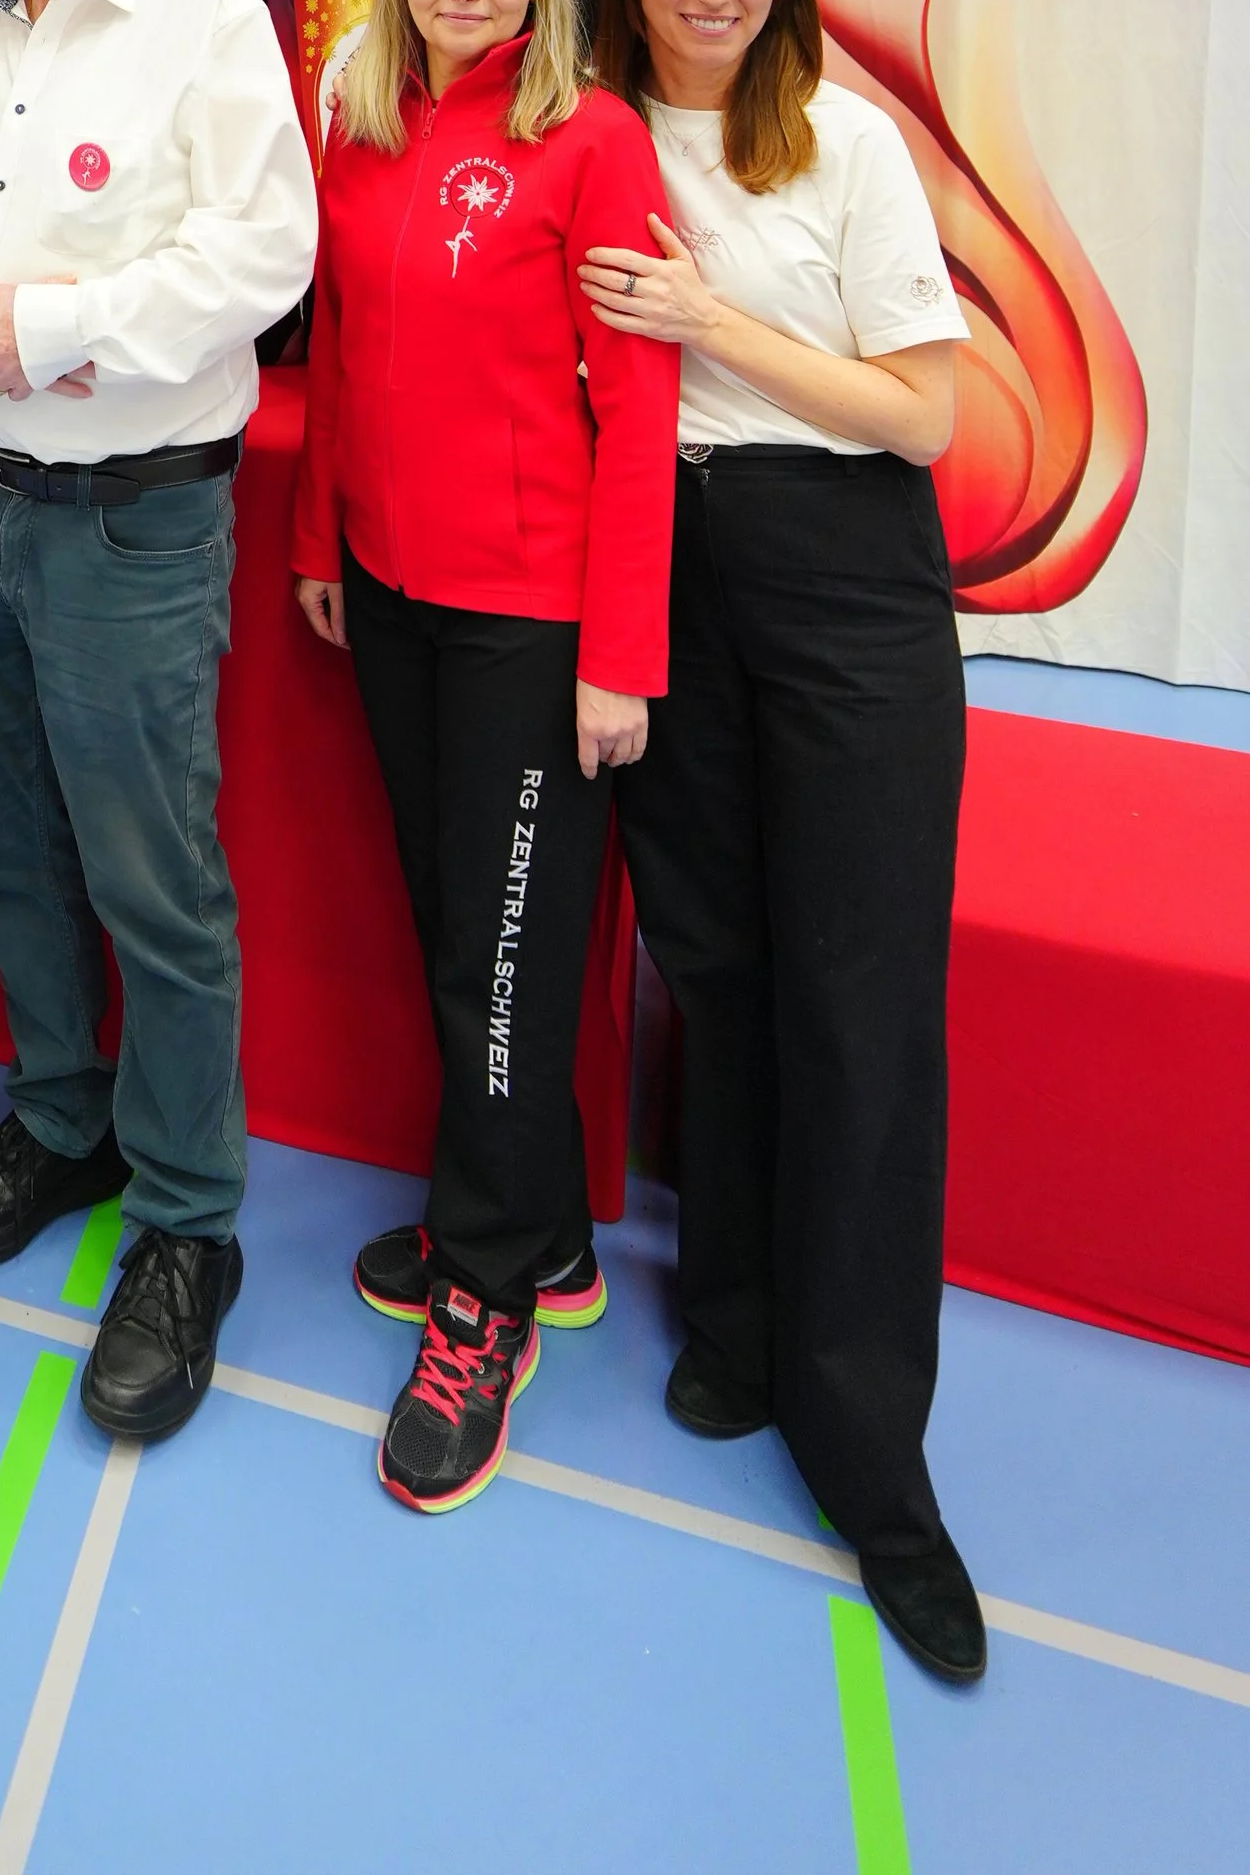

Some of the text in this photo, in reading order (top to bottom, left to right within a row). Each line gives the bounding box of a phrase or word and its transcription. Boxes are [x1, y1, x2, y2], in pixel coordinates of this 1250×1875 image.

[439, 156, 516, 219] RG ZENTRALSCHWEIZ
[488, 768, 544, 1098] RG ZENTRALSCHWEIZ
